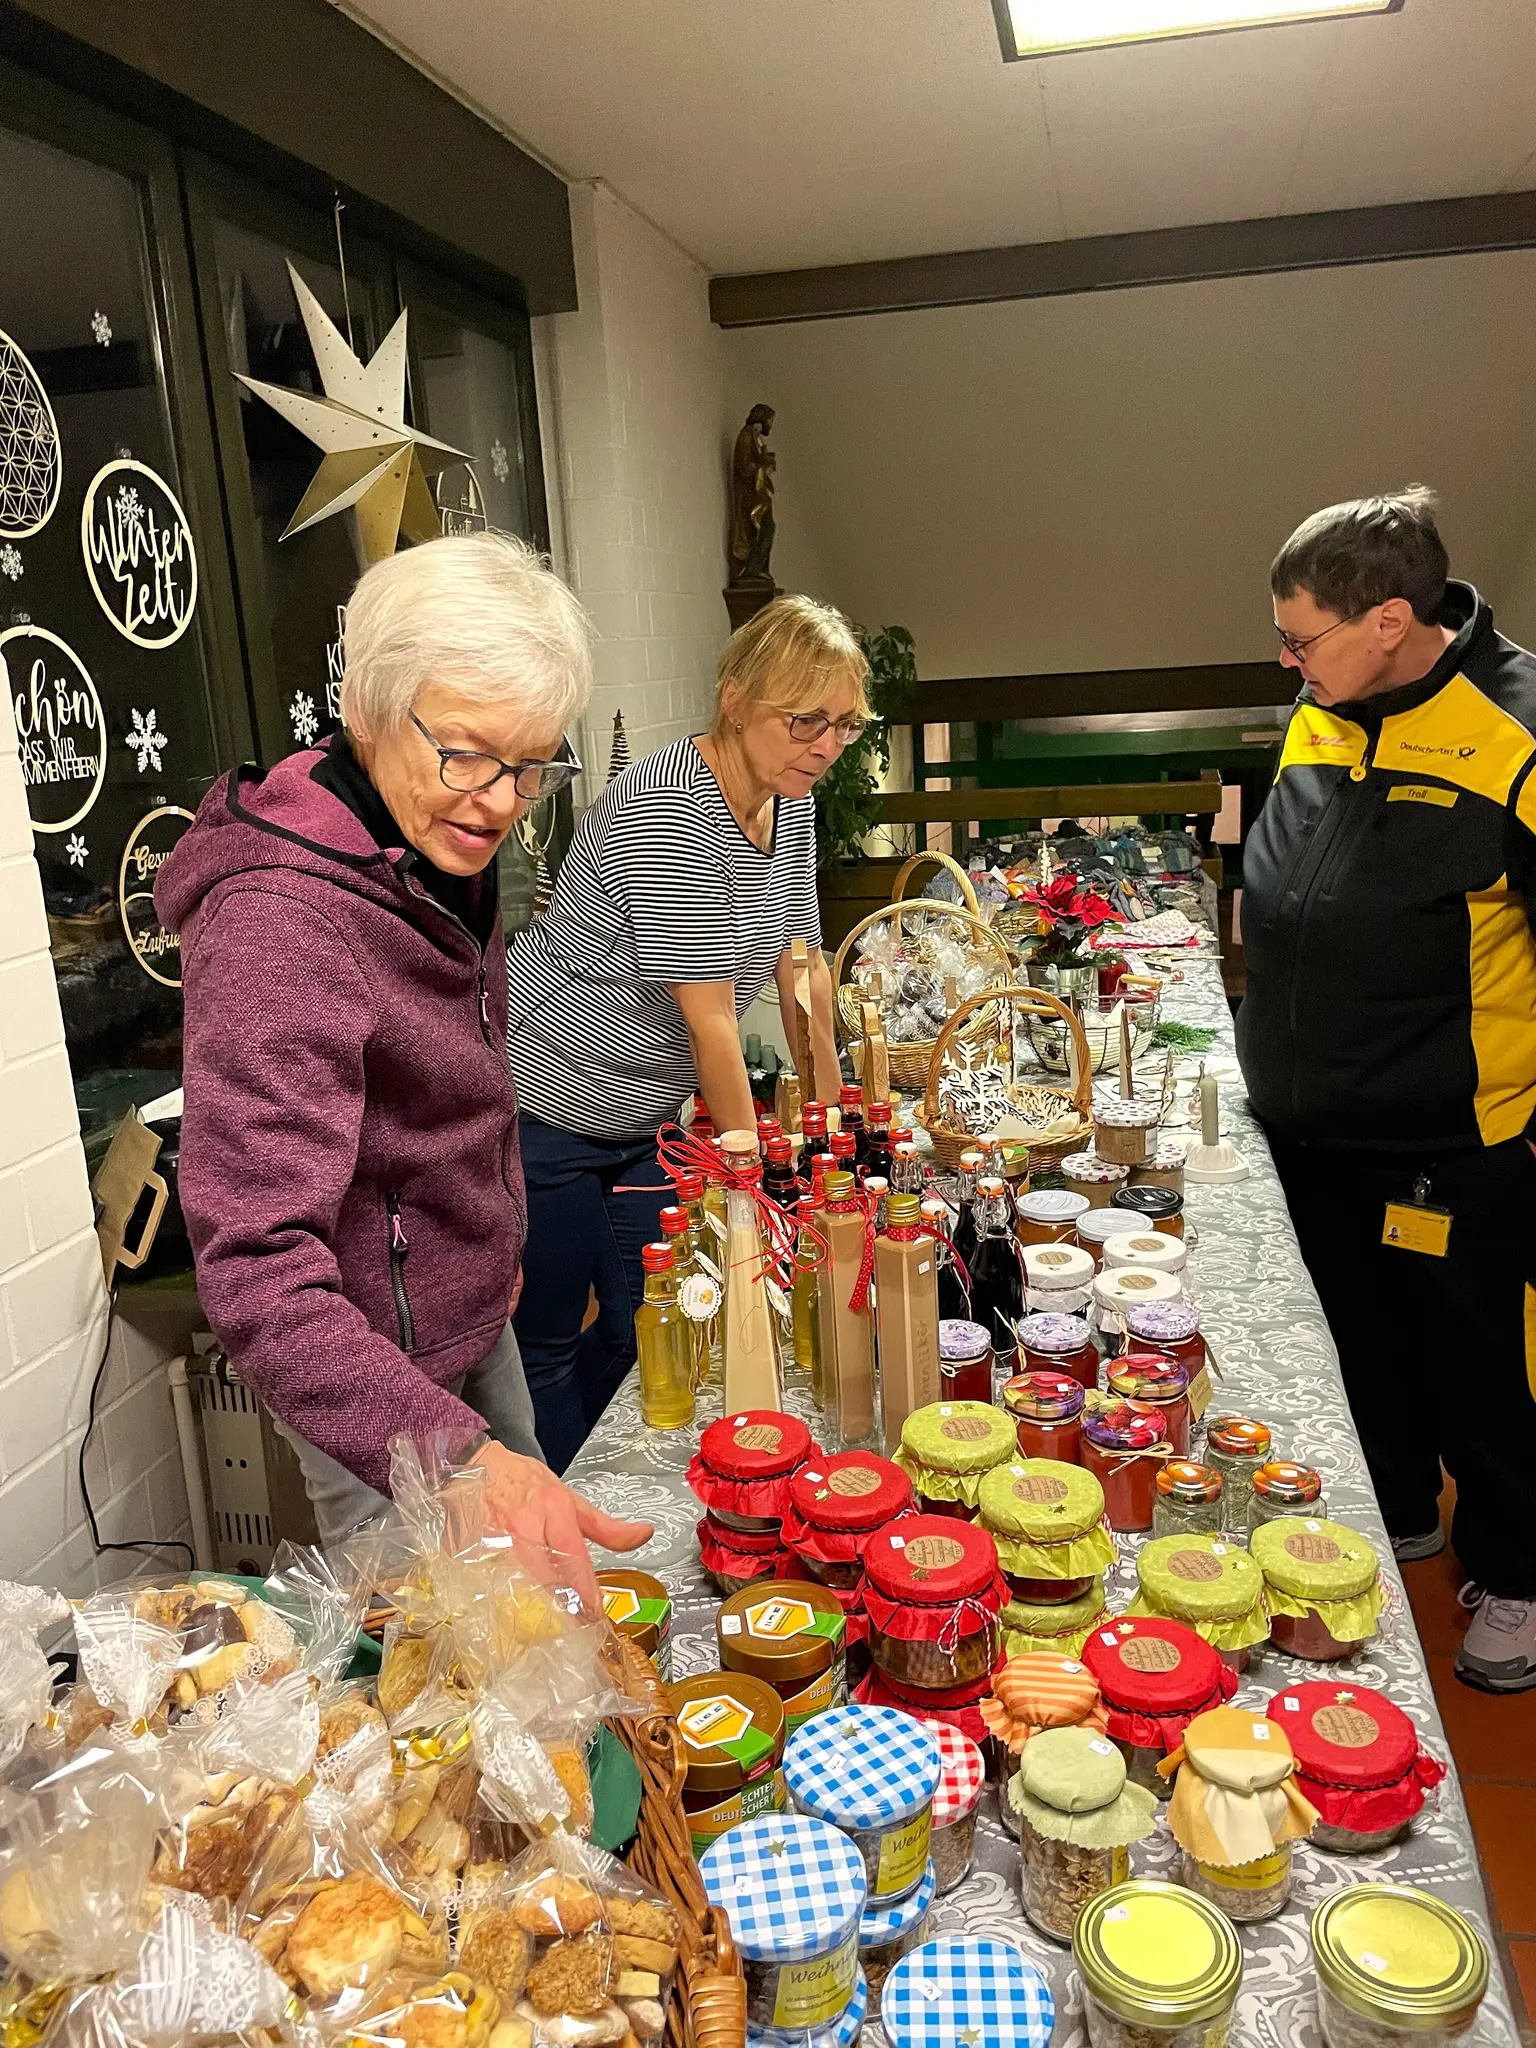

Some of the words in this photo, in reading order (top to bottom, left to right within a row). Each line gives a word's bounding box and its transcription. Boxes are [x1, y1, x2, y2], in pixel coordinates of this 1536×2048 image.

[89, 496, 190, 581] Winter
[116, 560, 184, 632] Zeit
[15, 659, 97, 741] chön
[50, 737, 76, 763] WIR
[135, 845, 173, 880] Gesu
[136, 926, 181, 956] Zufrie
[741, 1779, 774, 1804] ECHTER
[712, 1795, 770, 1823] DEUTSCHER
